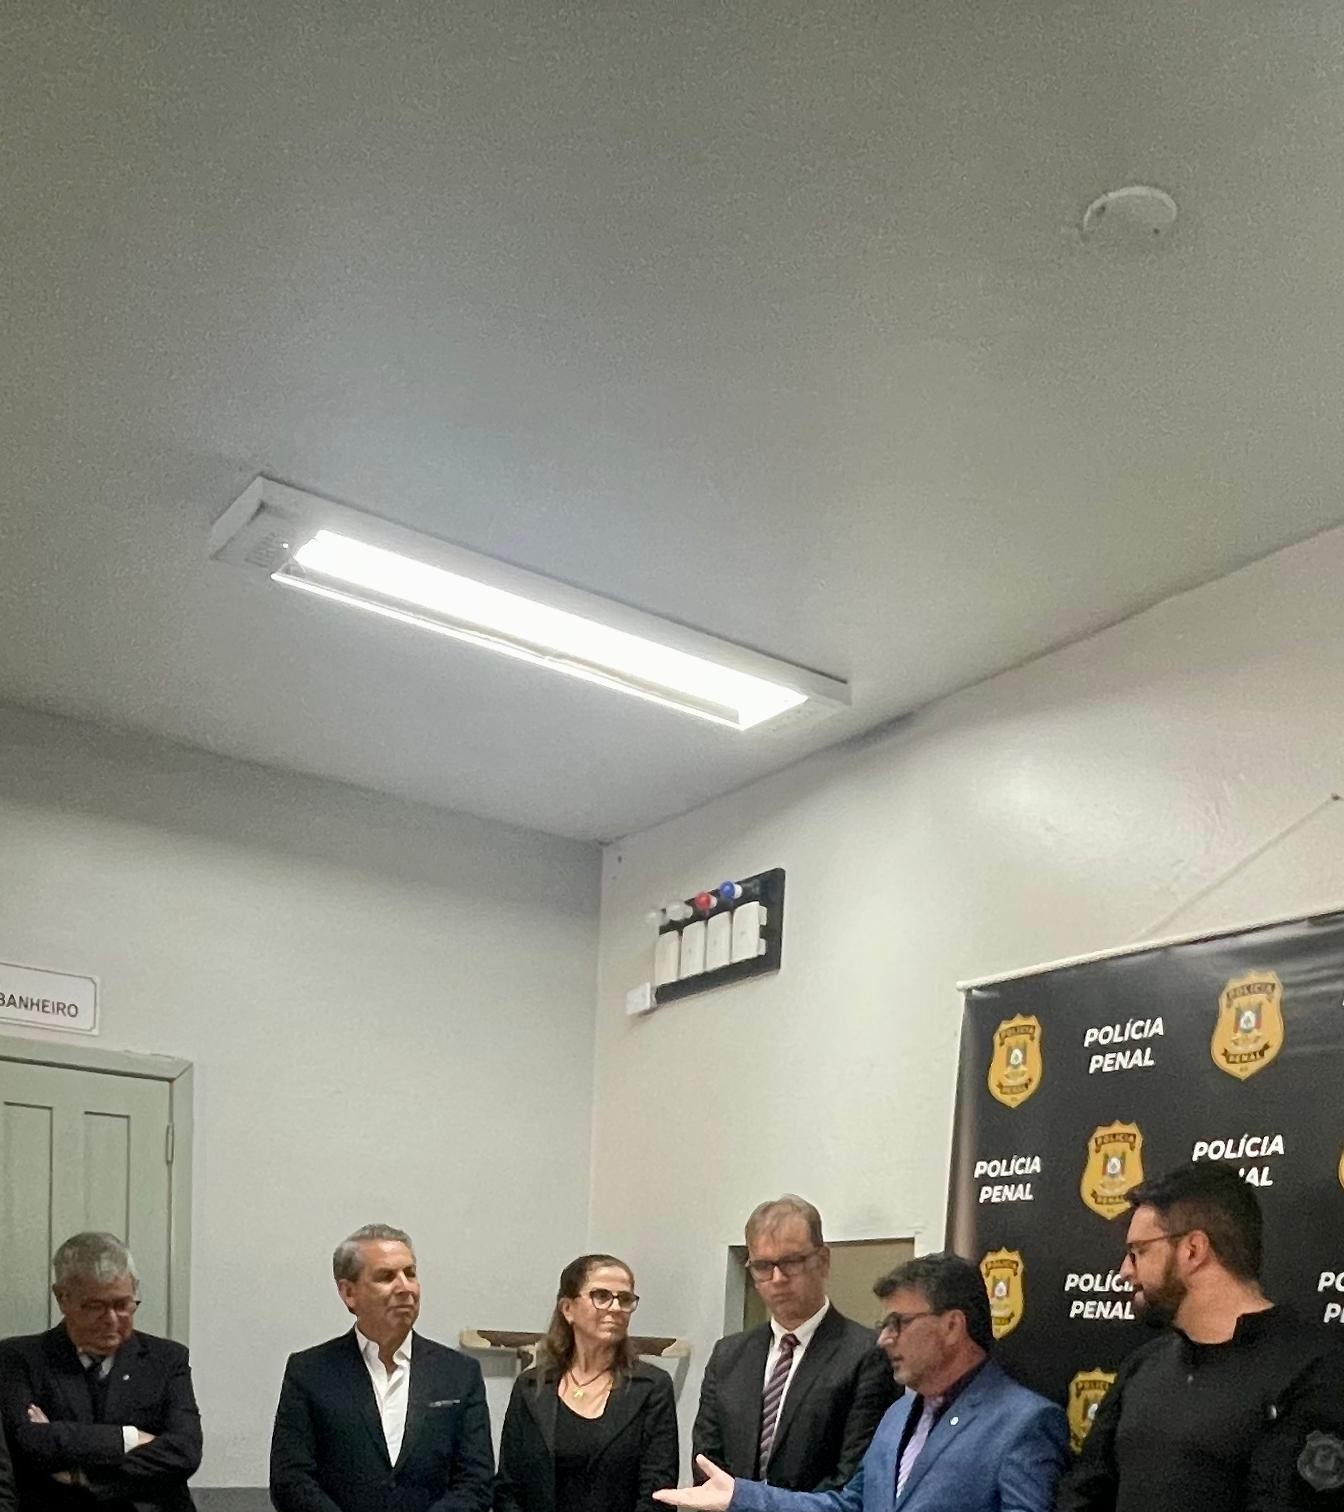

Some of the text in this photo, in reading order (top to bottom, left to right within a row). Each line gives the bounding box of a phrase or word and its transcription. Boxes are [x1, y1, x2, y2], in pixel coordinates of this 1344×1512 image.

[1083, 1016, 1164, 1048] POLÍCIA
[1088, 1047, 1155, 1074] PENAL
[1192, 1132, 1285, 1162] POLÍCIA
[974, 1154, 1041, 1178] POLÍCIA
[978, 1183, 1034, 1203] PENAL
[1069, 1300, 1135, 1320] PENAL
